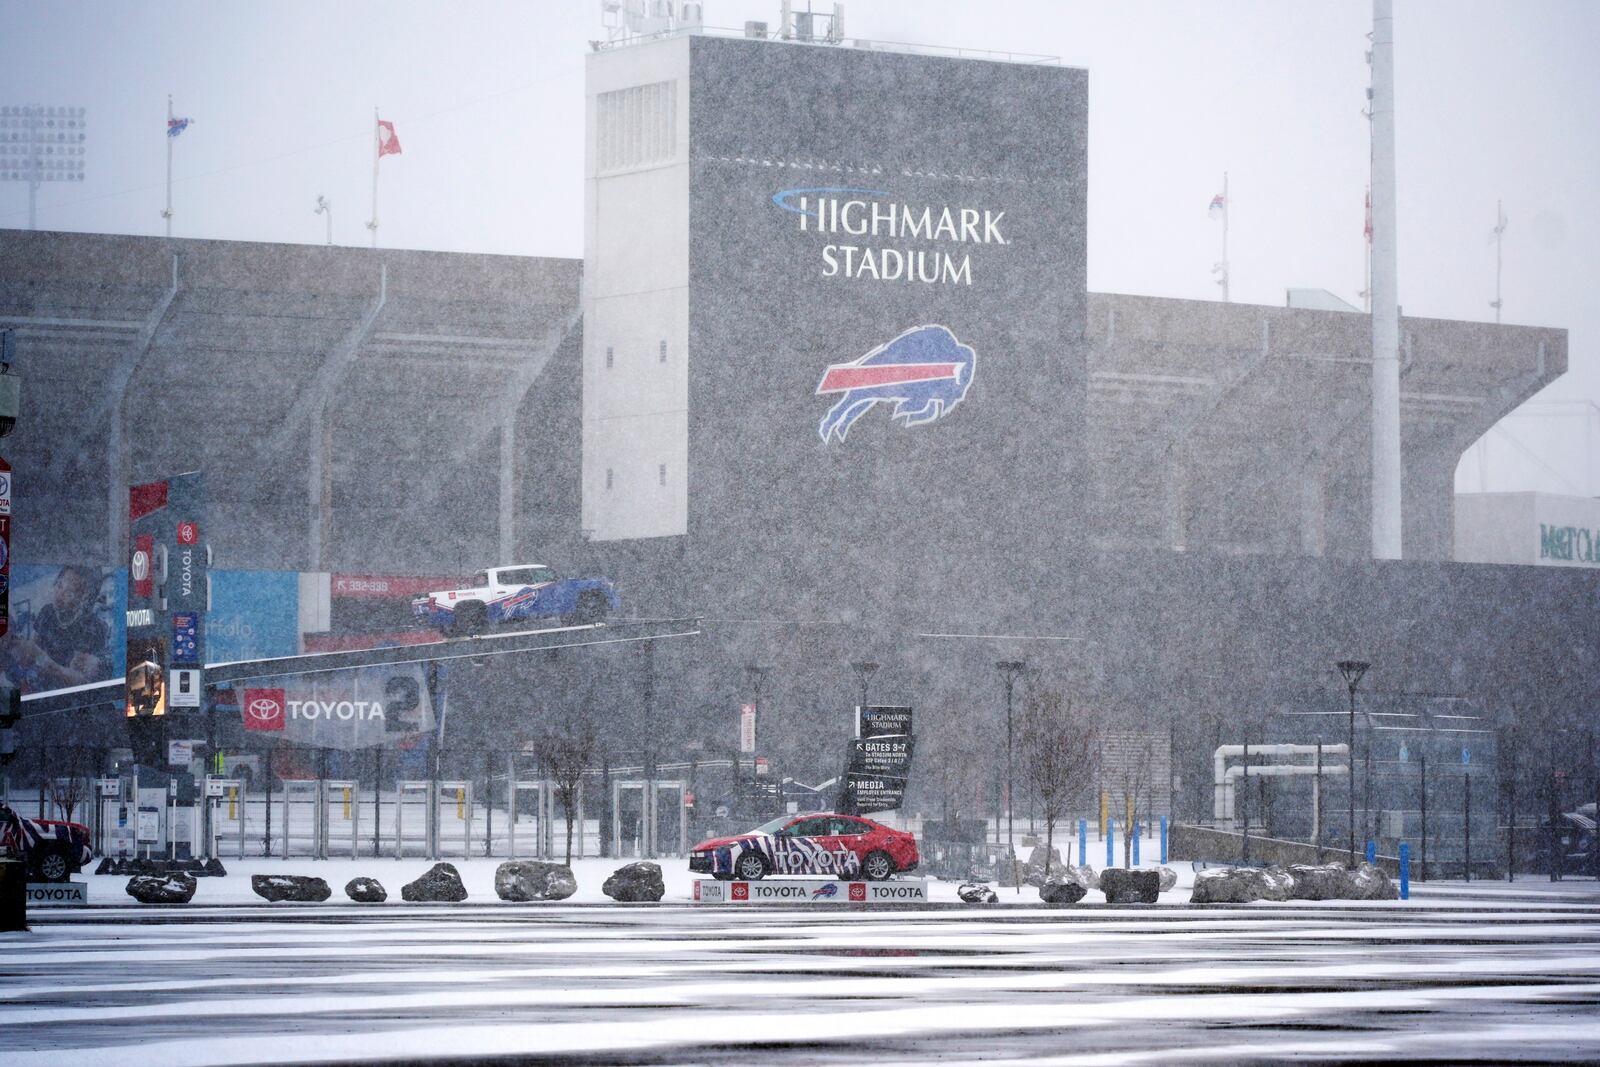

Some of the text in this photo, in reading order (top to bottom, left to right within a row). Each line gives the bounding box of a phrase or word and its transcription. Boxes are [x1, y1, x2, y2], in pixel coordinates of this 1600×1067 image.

[800, 197, 1006, 245] HIGHMARK
[822, 244, 972, 285] STADIUM
[182, 549, 192, 596] TOYOTA
[126, 610, 151, 627] TOYOTA
[287, 676, 421, 732] TOYOTA 2
[867, 713, 908, 721] HIGHMARK
[865, 743, 907, 752] GATES 3-7
[857, 781, 884, 790] MEDIA
[775, 850, 860, 868] TOYOTA
[26, 889, 82, 900] TOYOTA
[702, 885, 722, 897] TOYOTA
[754, 886, 923, 898] TOYOTA TOYOTA
